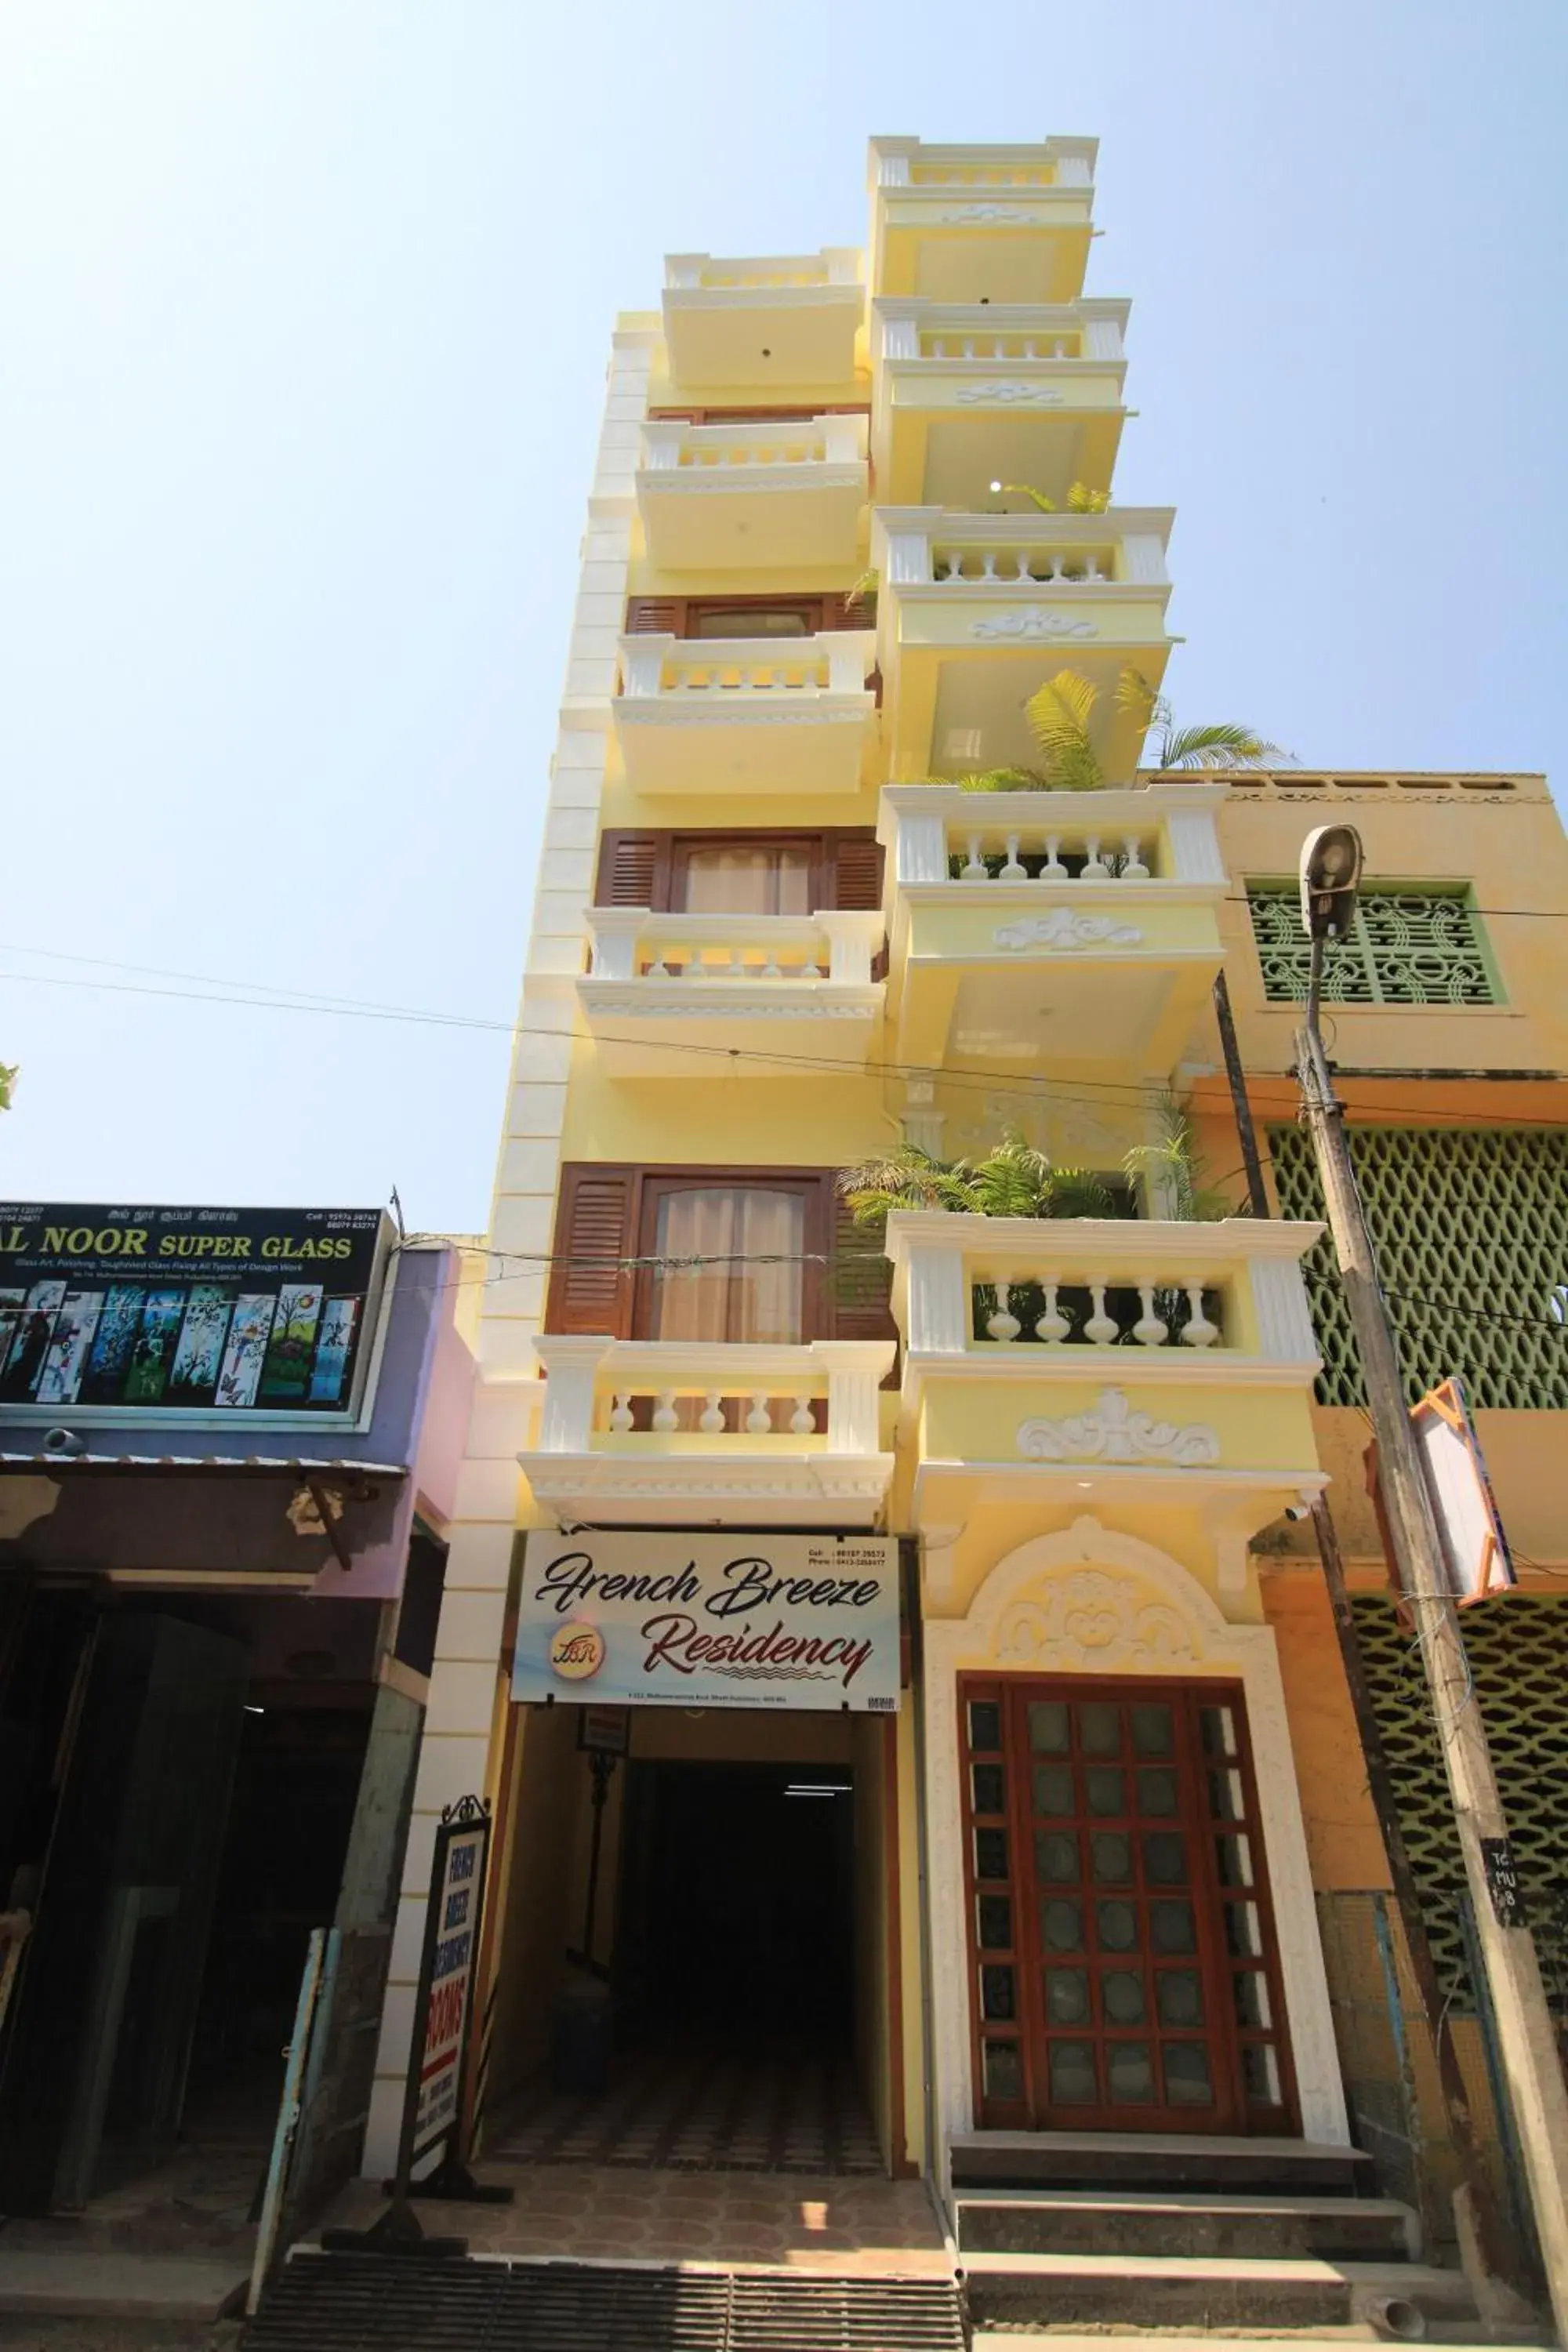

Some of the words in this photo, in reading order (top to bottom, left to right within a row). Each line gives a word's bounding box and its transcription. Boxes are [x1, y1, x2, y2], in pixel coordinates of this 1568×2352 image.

[38, 1227, 148, 1255] NOOR
[159, 1235, 252, 1258] SUPER
[261, 1236, 352, 1259] GLASS
[535, 1552, 702, 1613] French
[704, 1557, 882, 1619] Breeze
[641, 1613, 876, 1689] Residency
[426, 1975, 466, 2053] ROOMS
